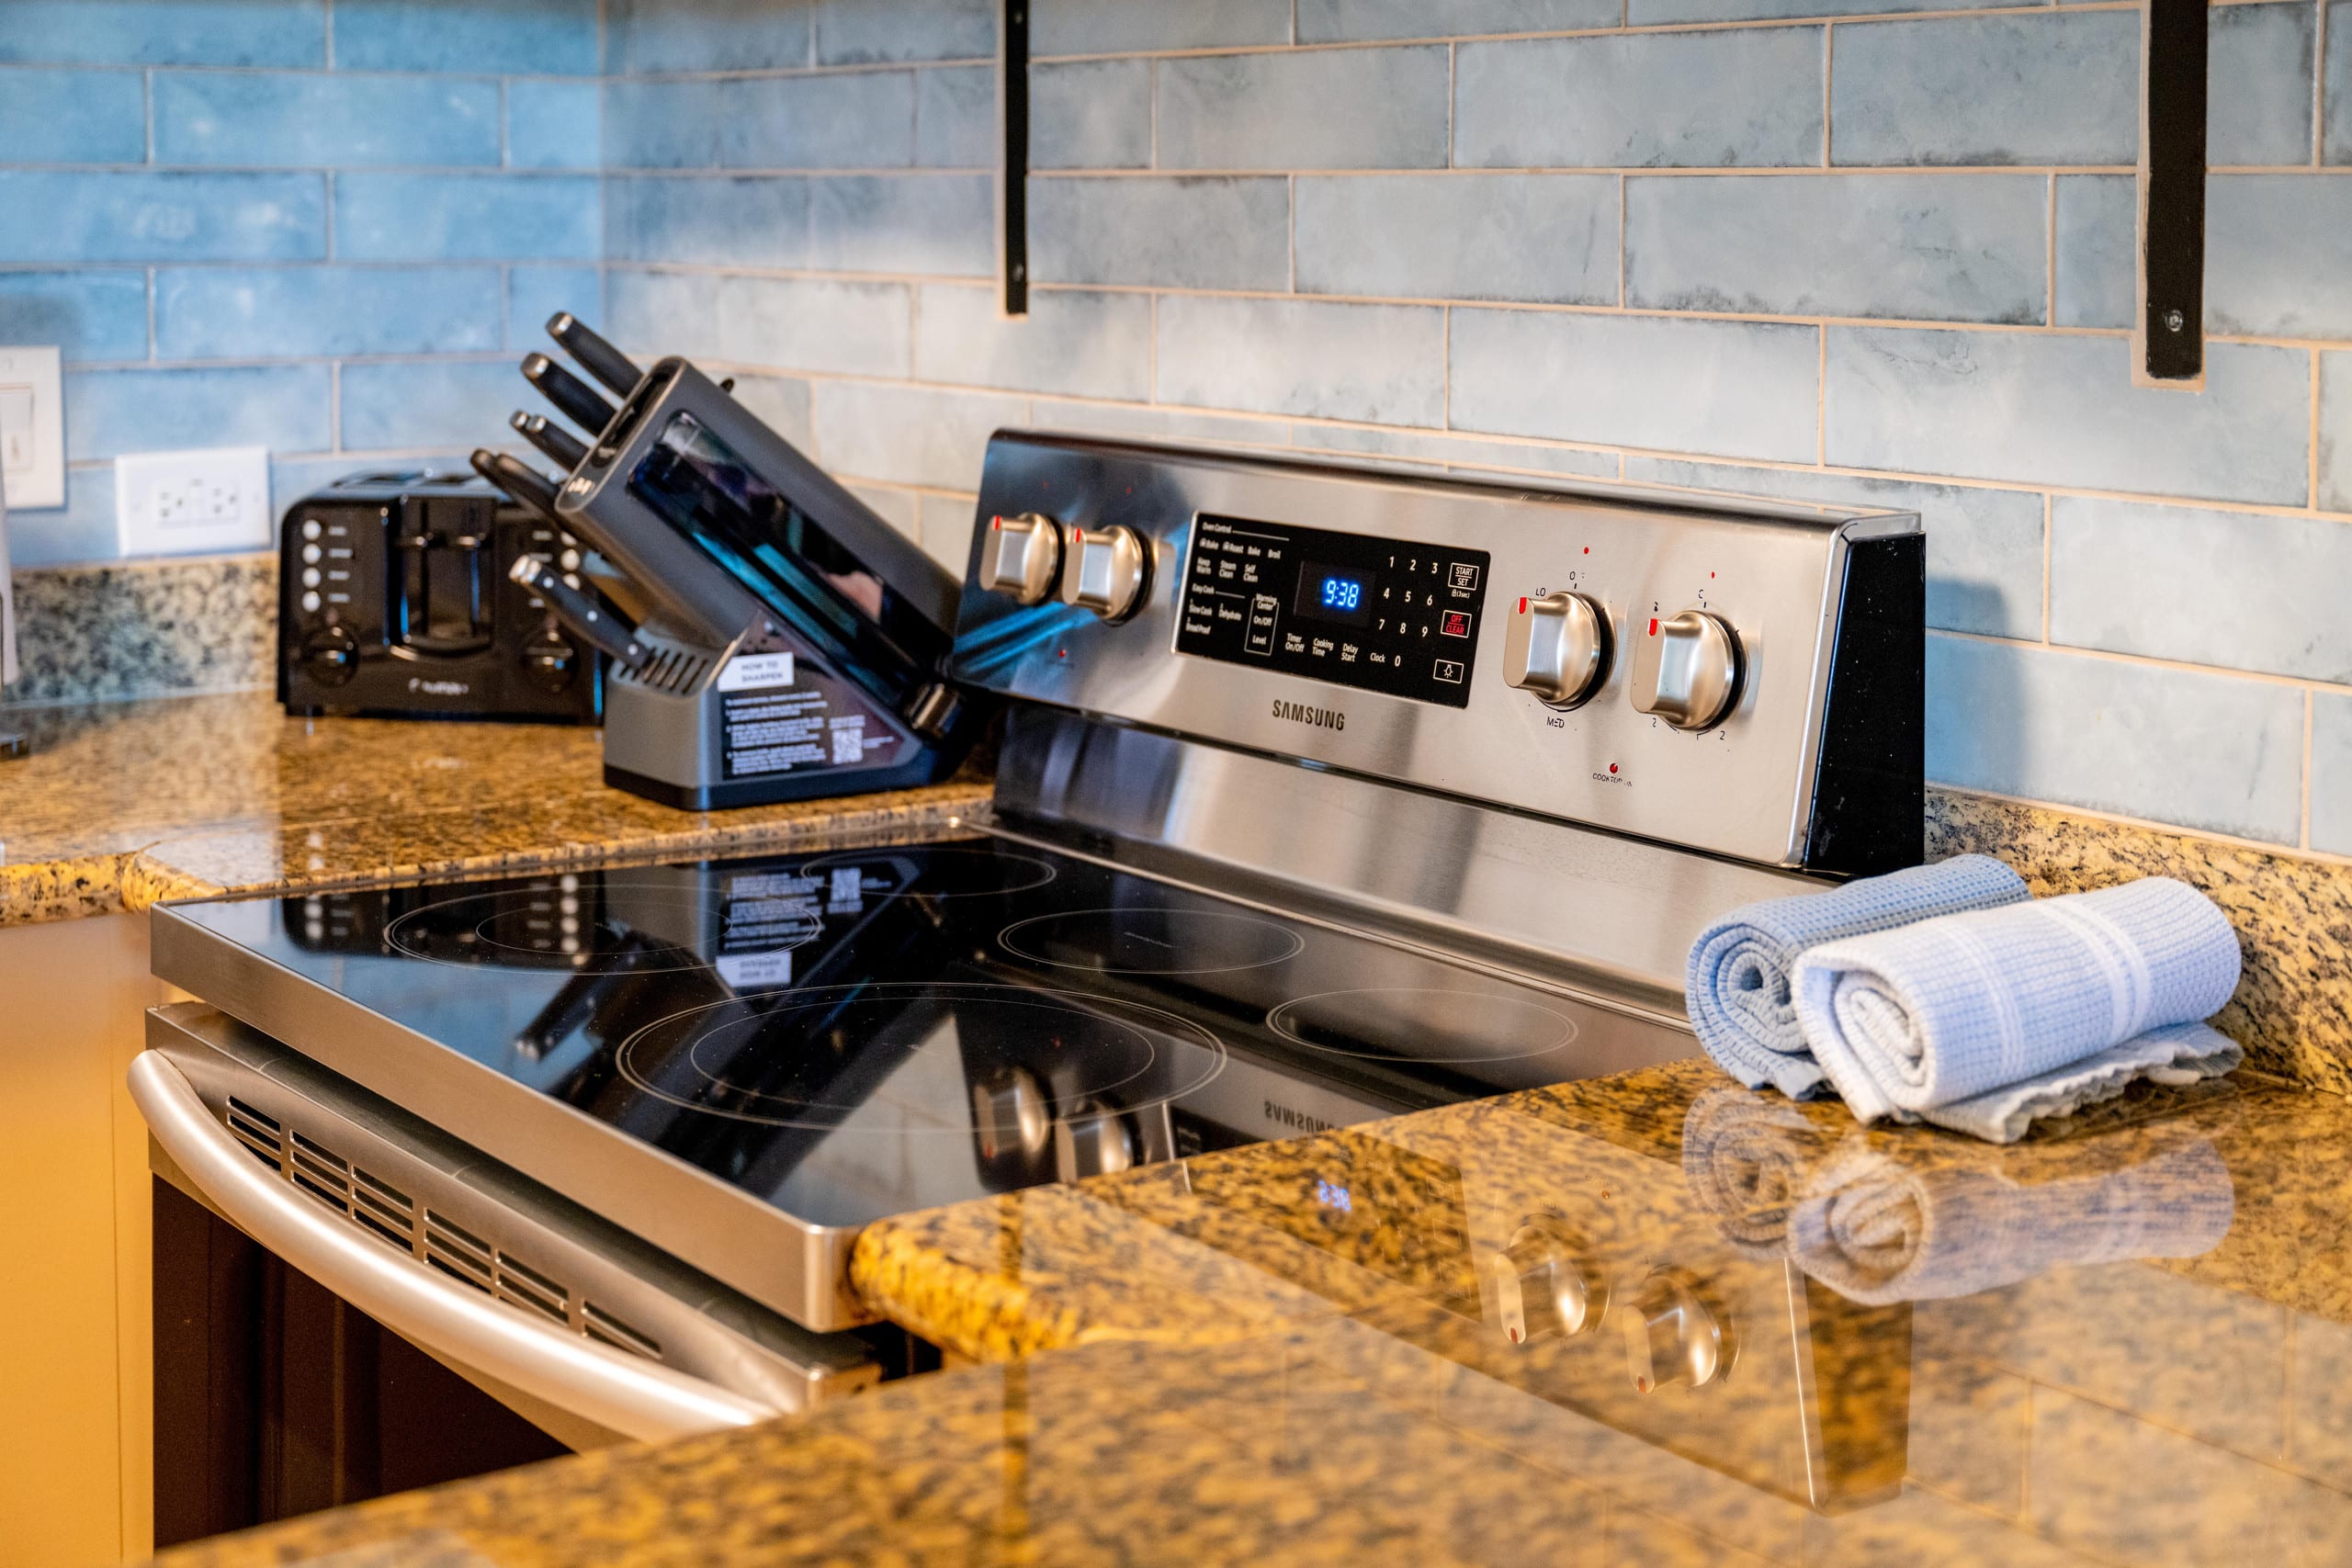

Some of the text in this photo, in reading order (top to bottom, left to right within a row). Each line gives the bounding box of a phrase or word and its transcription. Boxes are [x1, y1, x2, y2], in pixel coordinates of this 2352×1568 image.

[1215, 523, 1232, 534] Control
[1245, 563, 1256, 574] Self
[1389, 556, 1439, 574] 1 2 3
[1218, 570, 1234, 579] Clean
[1243, 572, 1259, 582] Clean
[1455, 566, 1474, 577] START
[1457, 577, 1469, 587] SET
[1324, 580, 1360, 608] 9:38
[1383, 587, 1433, 606] 4 5 6
[1257, 601, 1274, 611] Center
[1253, 615, 1273, 626] On/Off
[1451, 614, 1464, 624] OFF
[1379, 618, 1429, 637] 7 8 9
[1445, 624, 1464, 635] CLEAR
[1252, 634, 1267, 646] Level
[1287, 632, 1303, 643] Timer
[1285, 641, 1305, 653] On/Off
[1313, 637, 1334, 651] Cooking
[1342, 643, 1359, 655] Delay
[1312, 646, 1326, 658] Time
[1341, 651, 1356, 662] Start
[1370, 652, 1386, 663] Clock
[1272, 699, 1345, 731] SAMSUNG
[1547, 716, 1565, 728] MED
